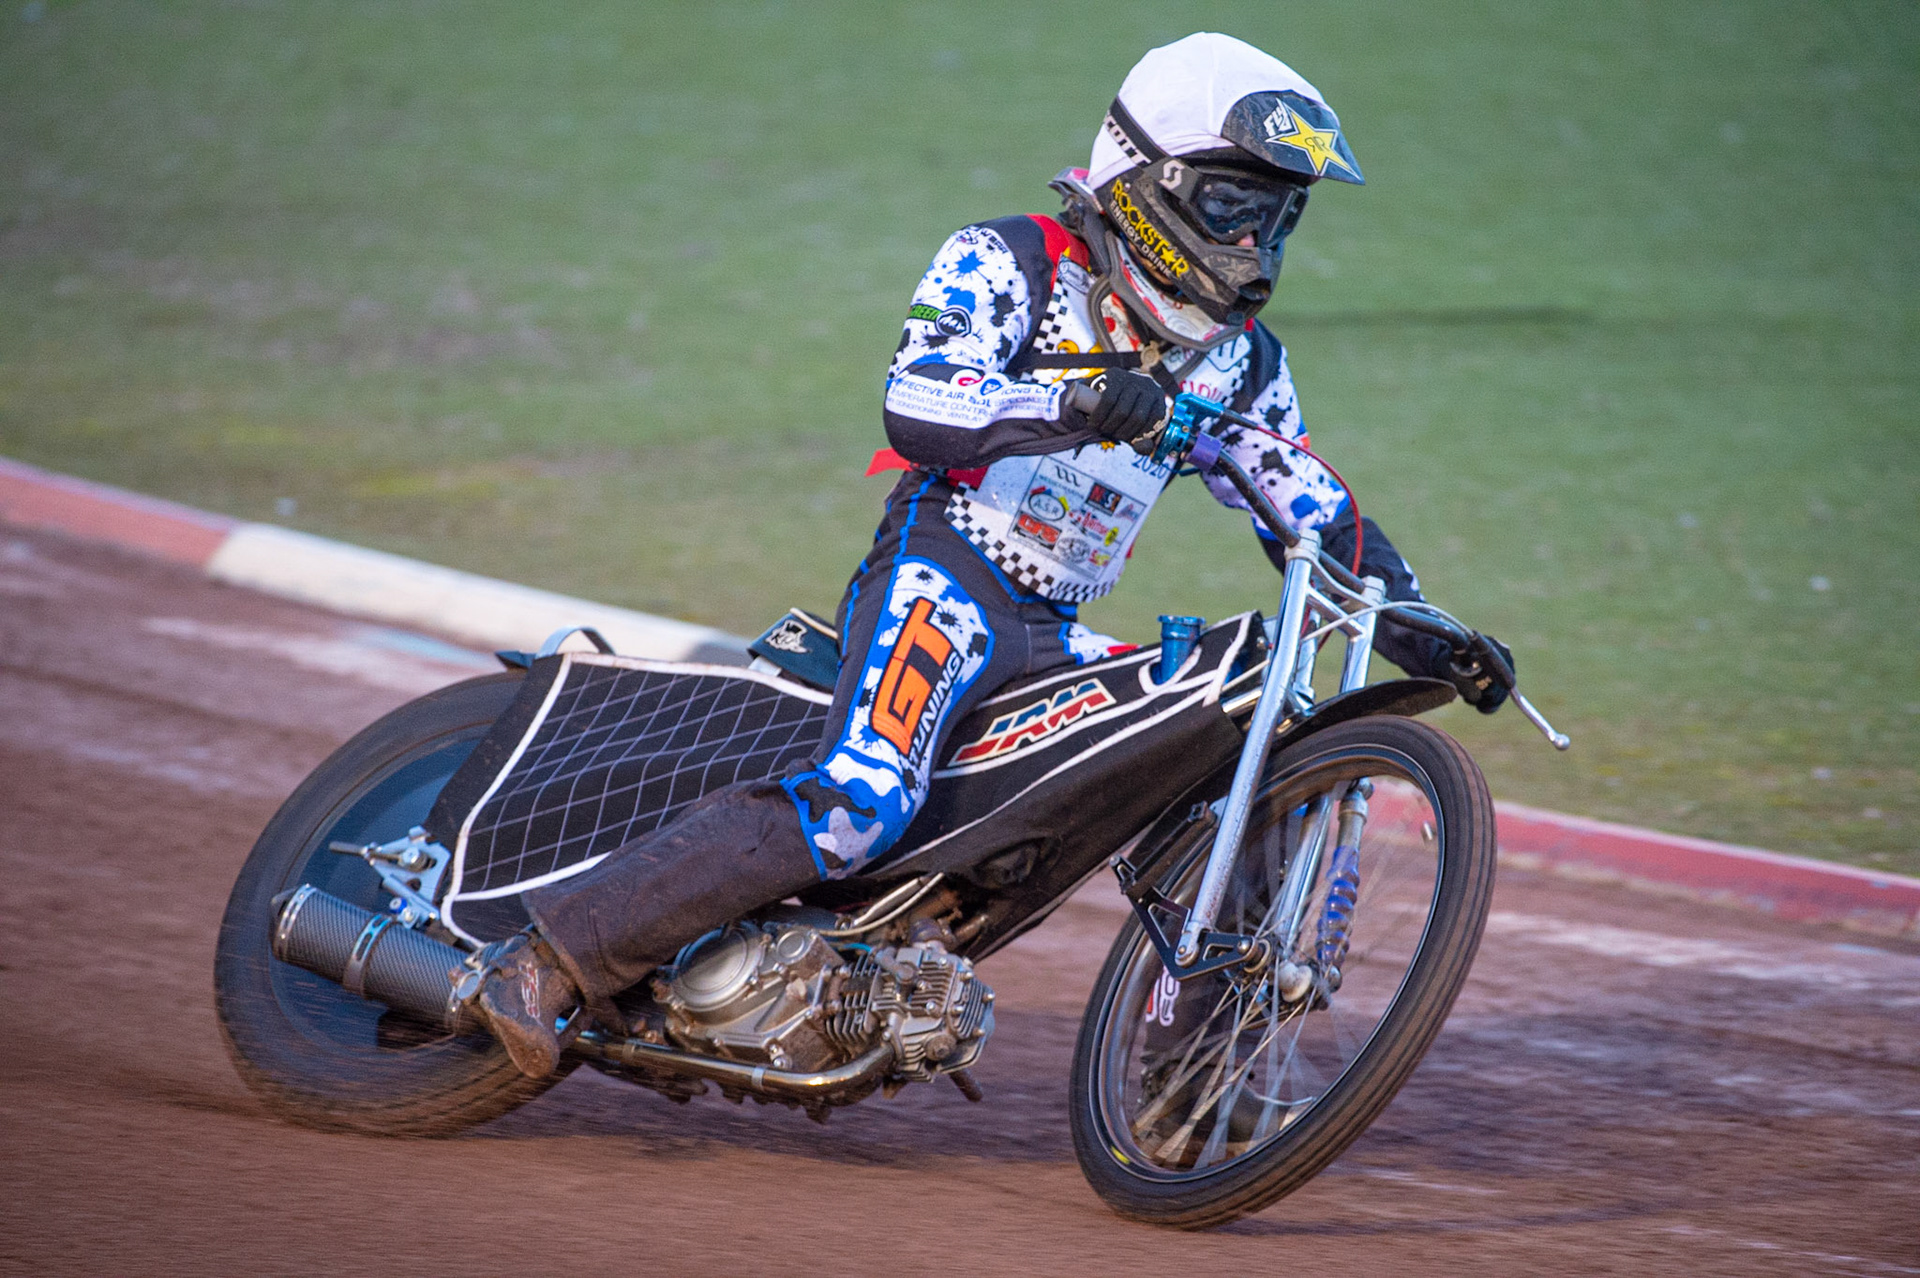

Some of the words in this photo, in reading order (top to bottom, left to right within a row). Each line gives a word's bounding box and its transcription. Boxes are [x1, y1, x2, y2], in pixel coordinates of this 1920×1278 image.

[1103, 109, 1151, 166] COTT
[1263, 104, 1295, 136] FLY
[1110, 200, 1141, 242] ENERGY
[1141, 243, 1173, 277] DRINK
[945, 391, 965, 400] AIR
[1131, 453, 1171, 480] 2020
[869, 597, 952, 756] GT
[908, 650, 963, 767] TUNING
